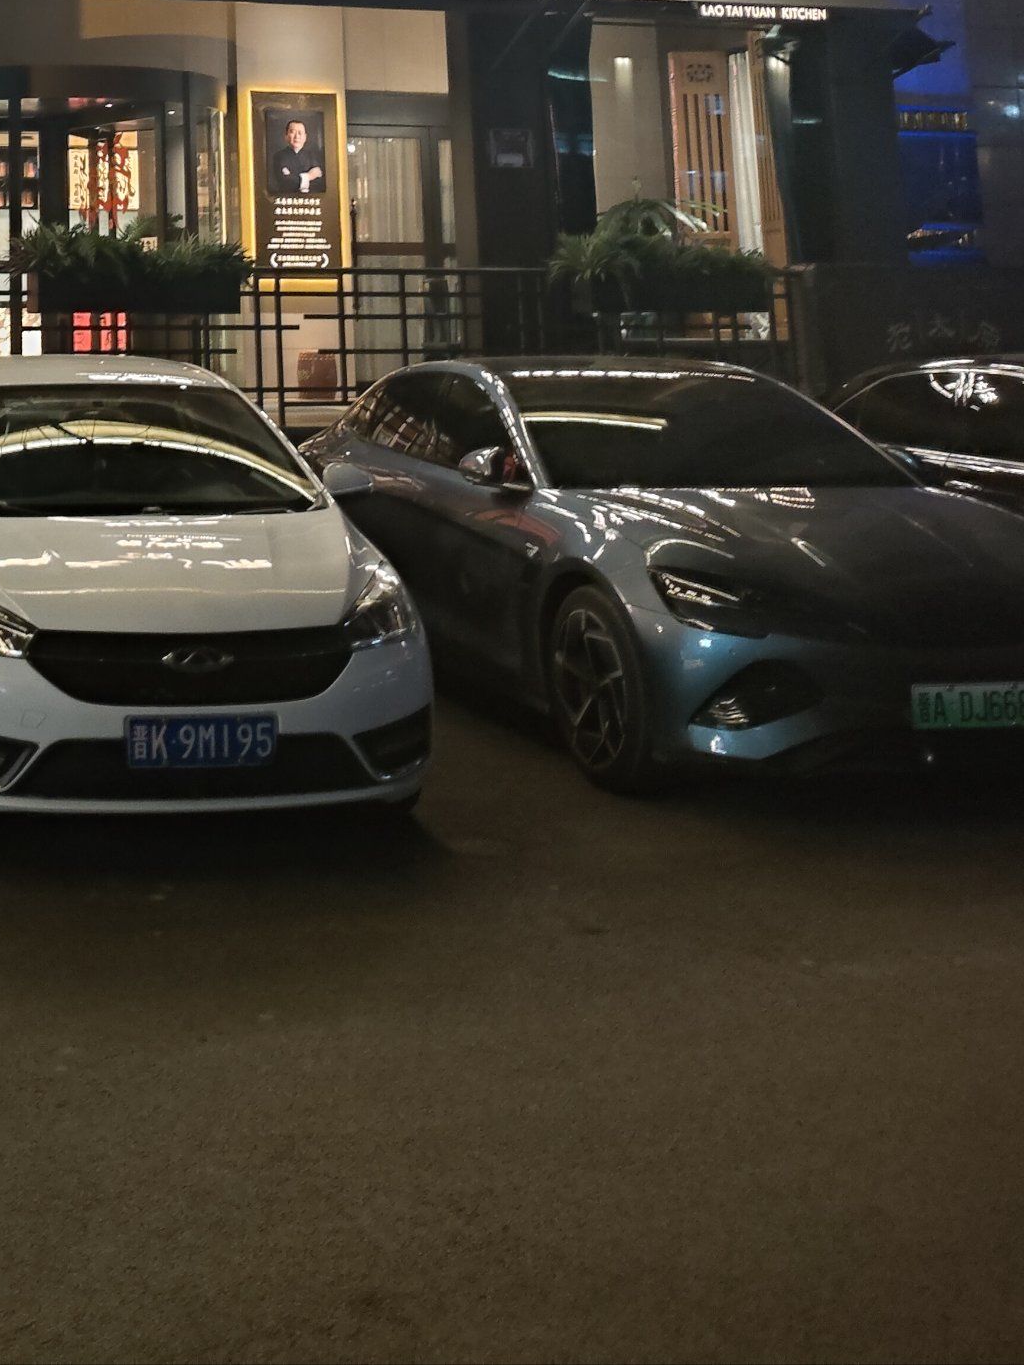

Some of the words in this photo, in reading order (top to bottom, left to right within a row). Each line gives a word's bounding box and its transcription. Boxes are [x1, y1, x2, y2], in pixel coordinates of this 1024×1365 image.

[700, 3, 724, 17] LAO
[725, 4, 743, 18] TAI
[744, 5, 776, 19] YUAN
[781, 7, 827, 21] KITCHEN
